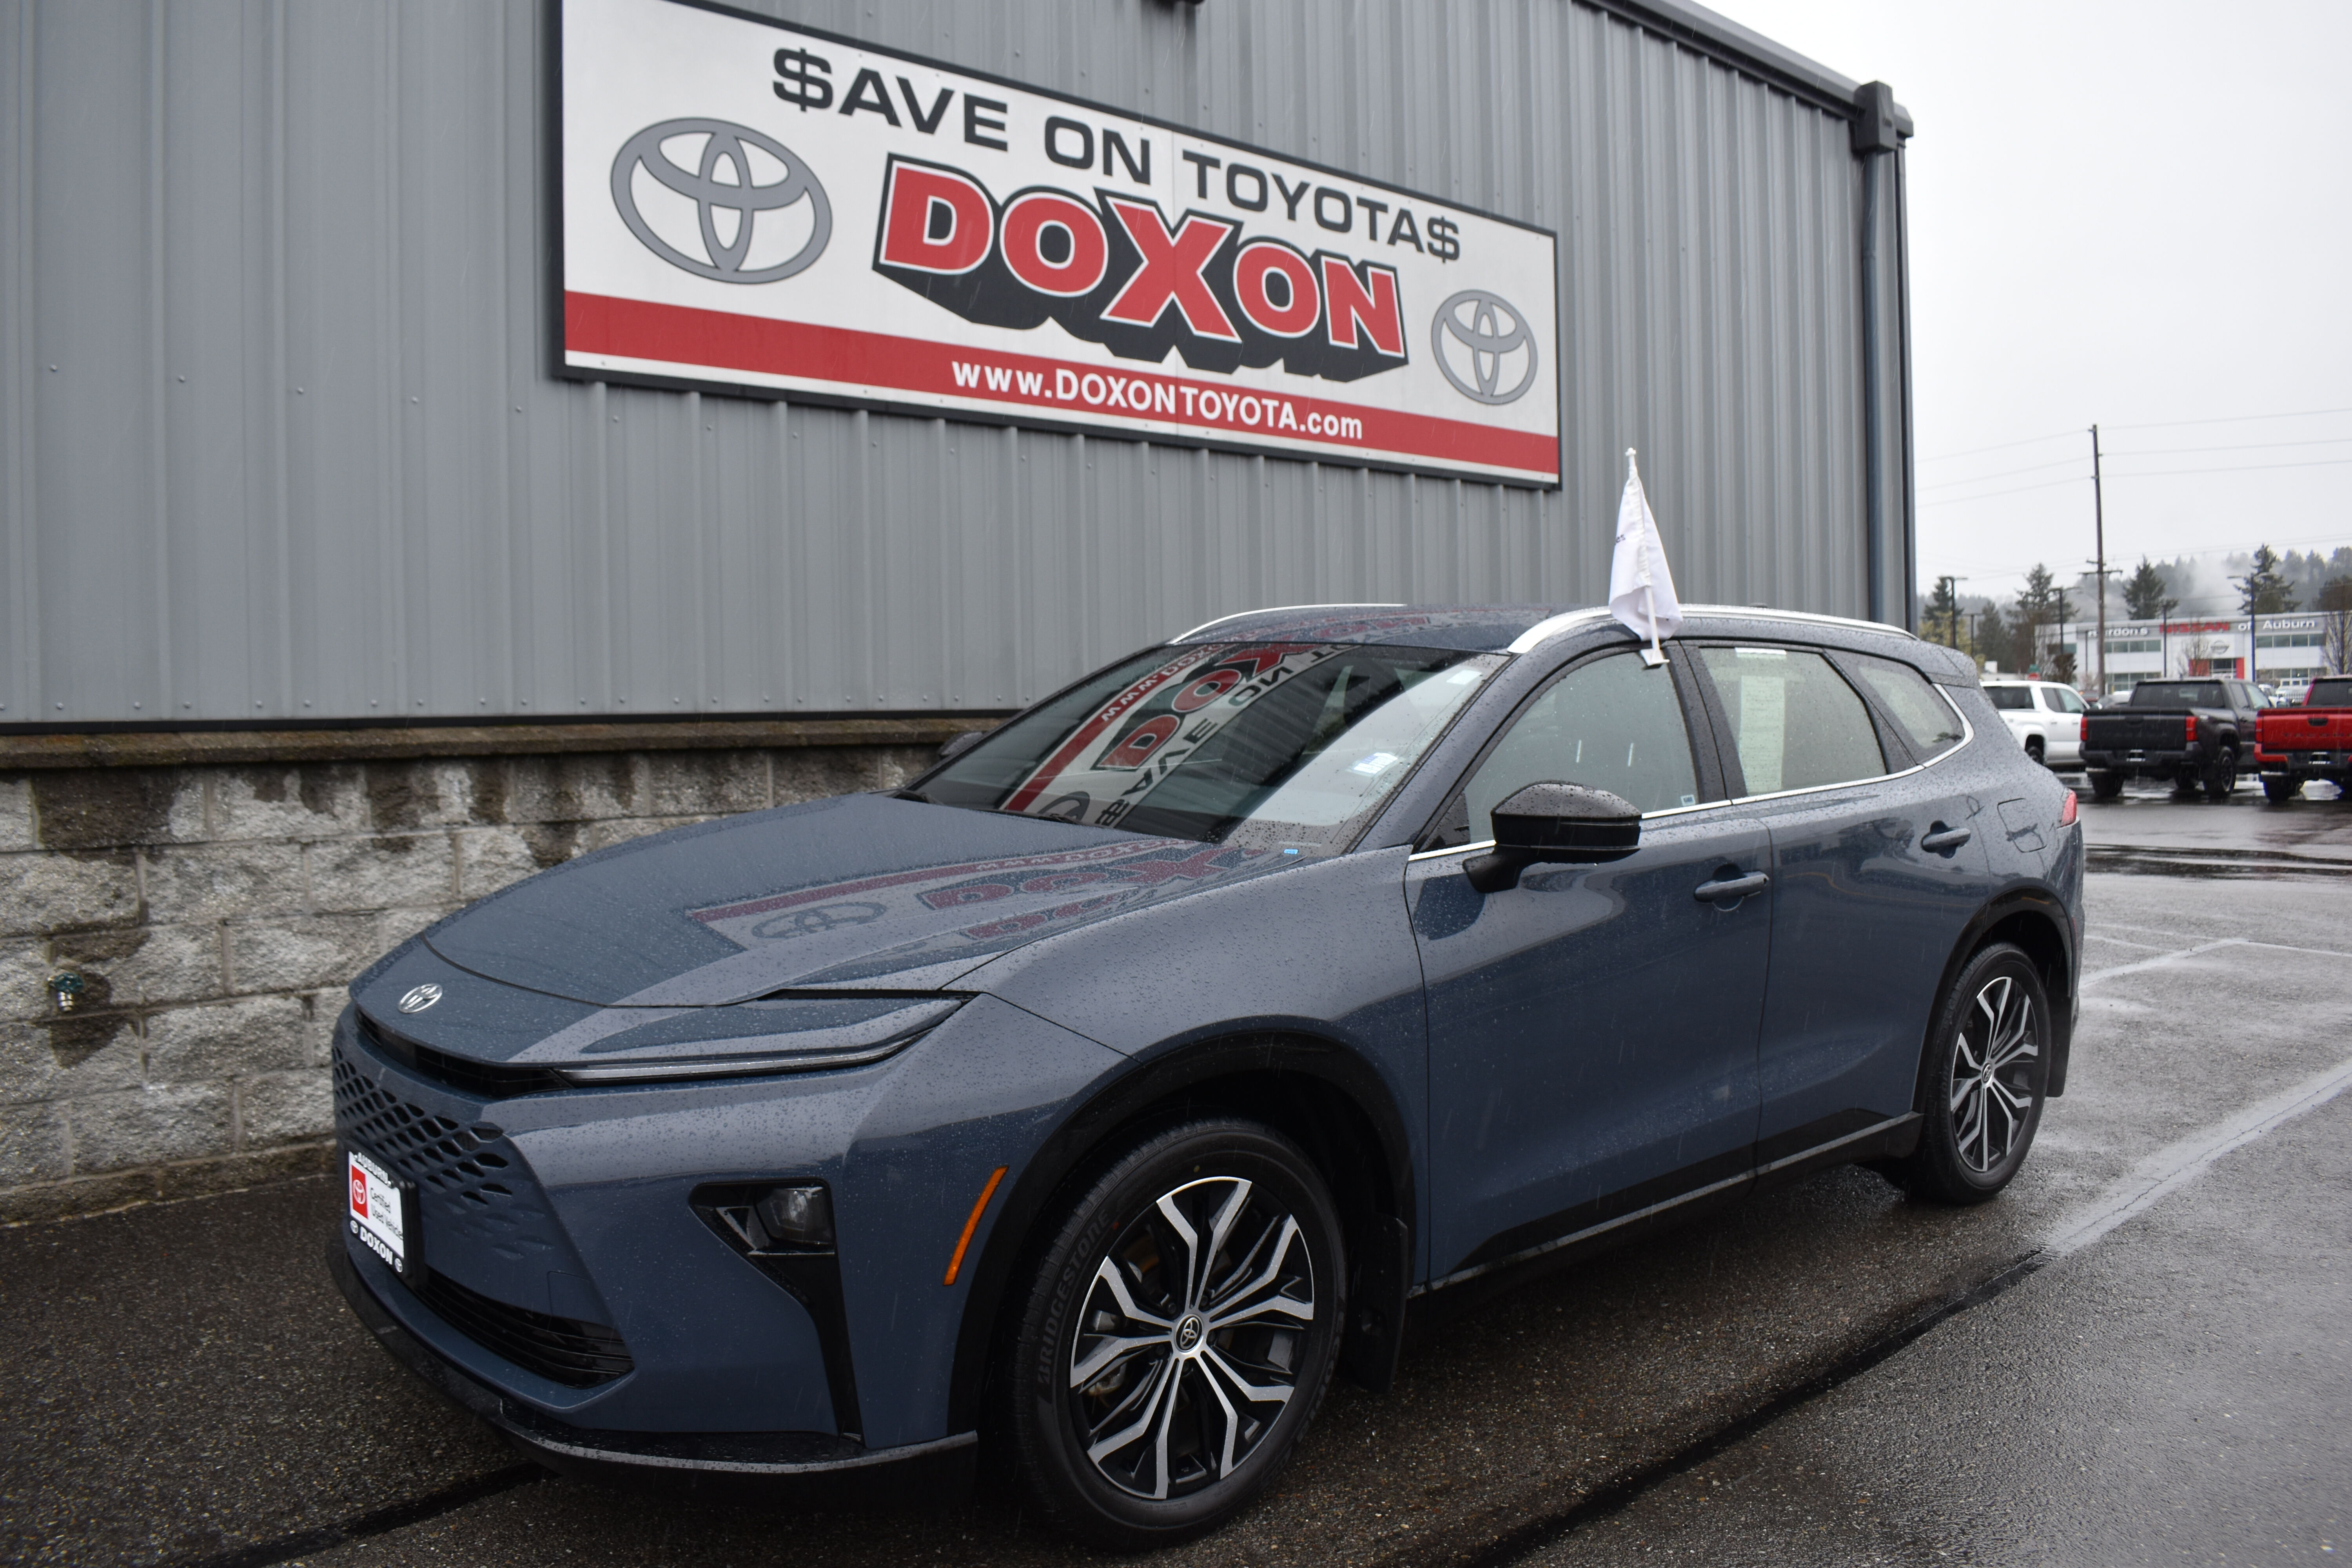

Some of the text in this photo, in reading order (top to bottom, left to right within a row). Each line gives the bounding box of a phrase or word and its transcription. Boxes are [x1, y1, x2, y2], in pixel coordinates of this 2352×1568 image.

[772, 47, 1461, 263] $AVE ON TOYOTA$
[877, 156, 1409, 359] DOXON
[2160, 621, 2230, 633] NISSAN
[2263, 619, 2315, 630] Auburn
[359, 1226, 394, 1265] DOXON
[1038, 1209, 1109, 1385] BRIDGESTONE
